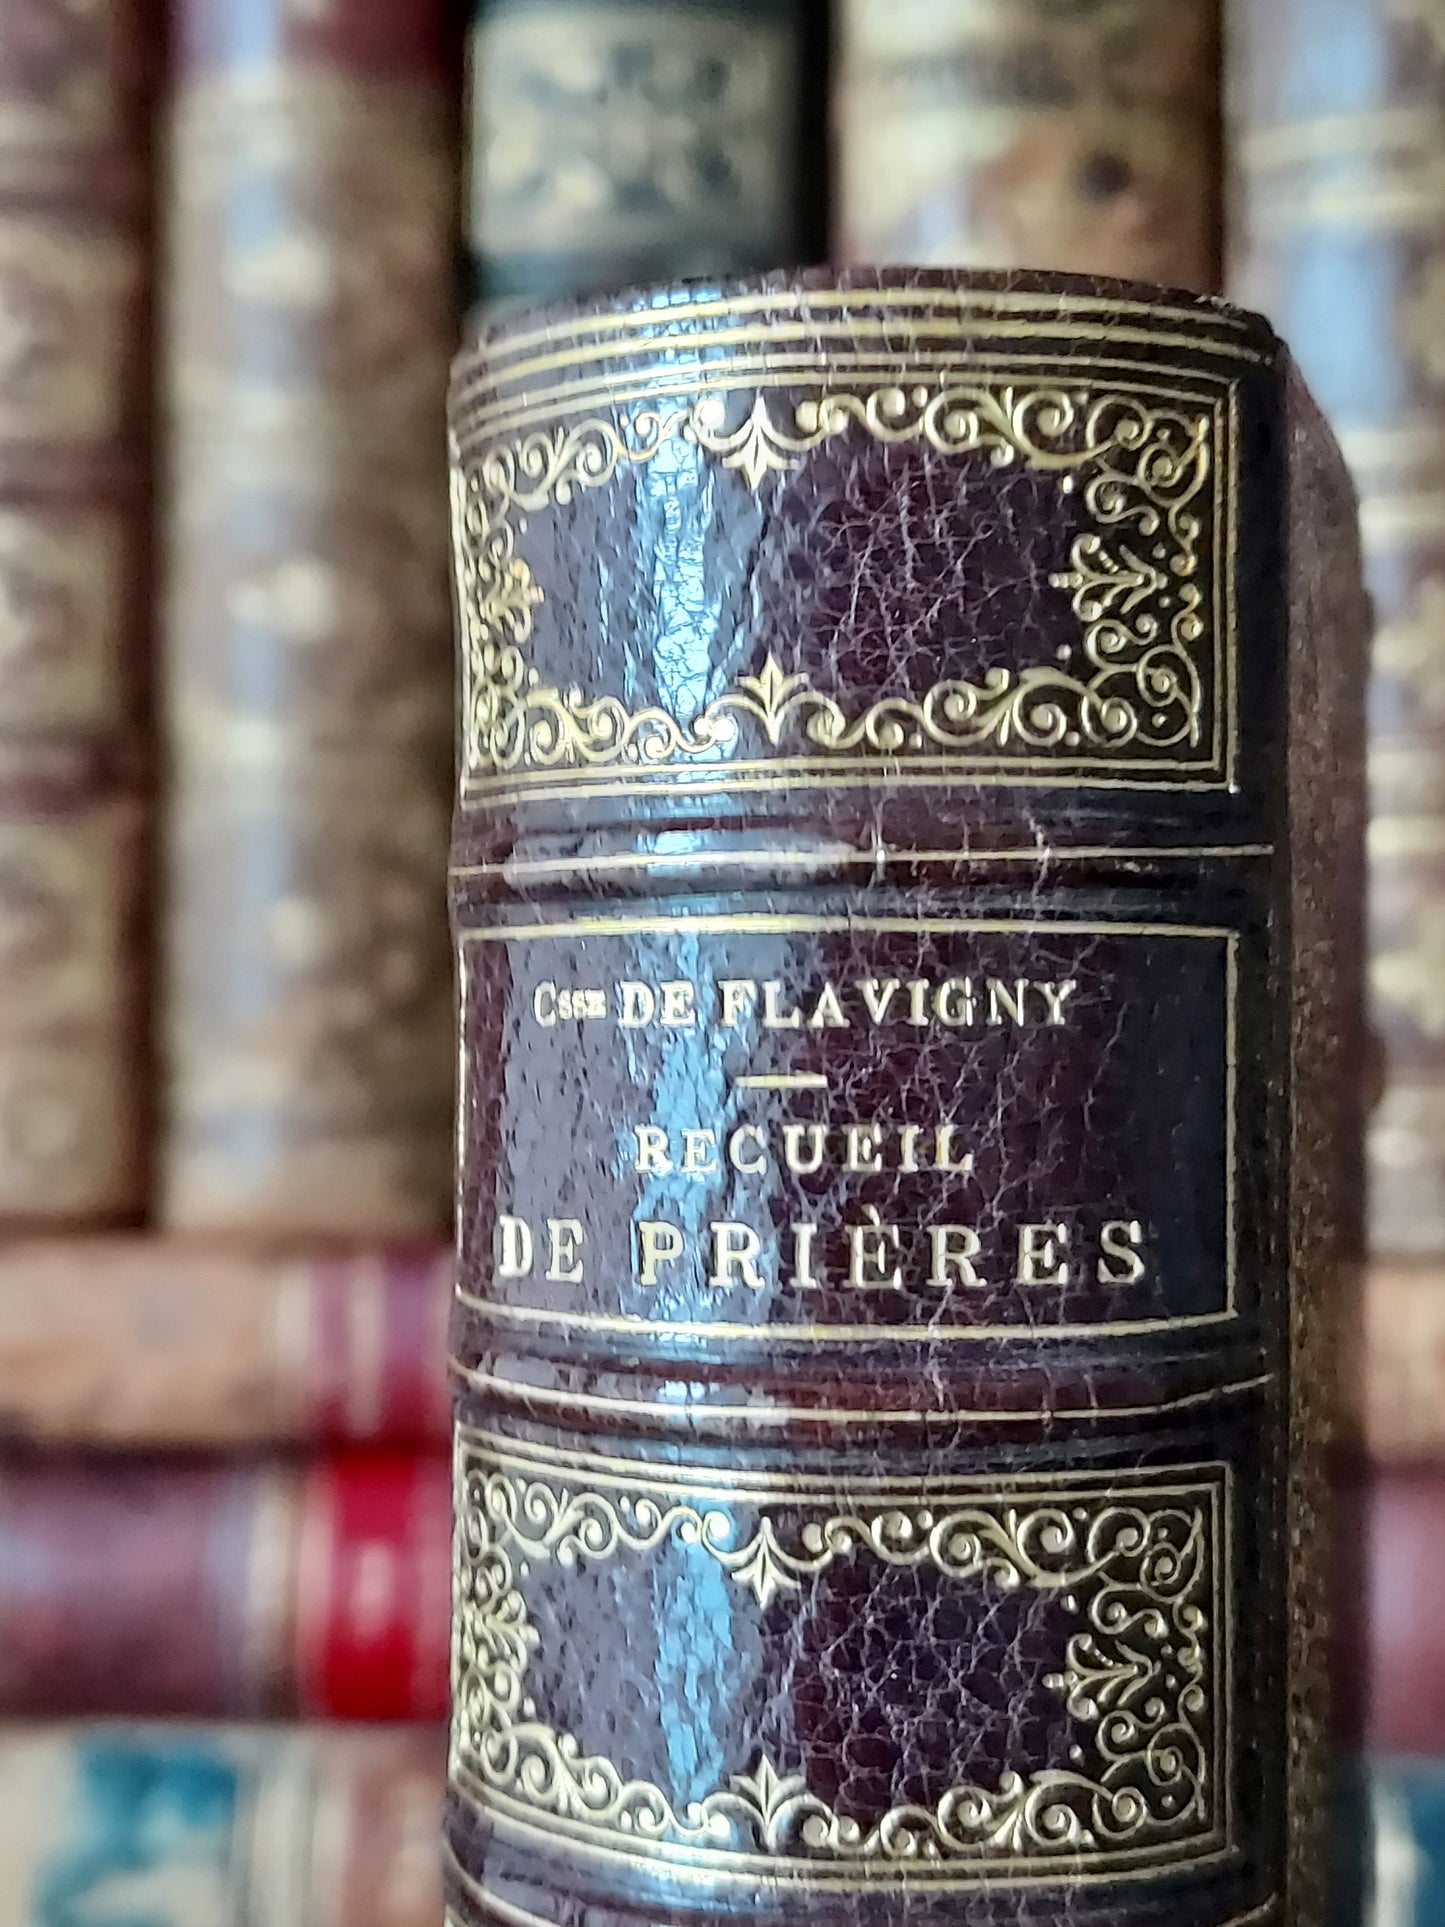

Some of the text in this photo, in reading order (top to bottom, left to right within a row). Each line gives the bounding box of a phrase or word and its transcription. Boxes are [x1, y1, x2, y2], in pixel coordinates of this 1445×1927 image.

[618, 980, 696, 1028] DE
[718, 978, 1077, 1027] FLAVIGNY
[635, 1122, 974, 1175] RECUEIL
[497, 1205, 1145, 1290] DE PRIÈRES
